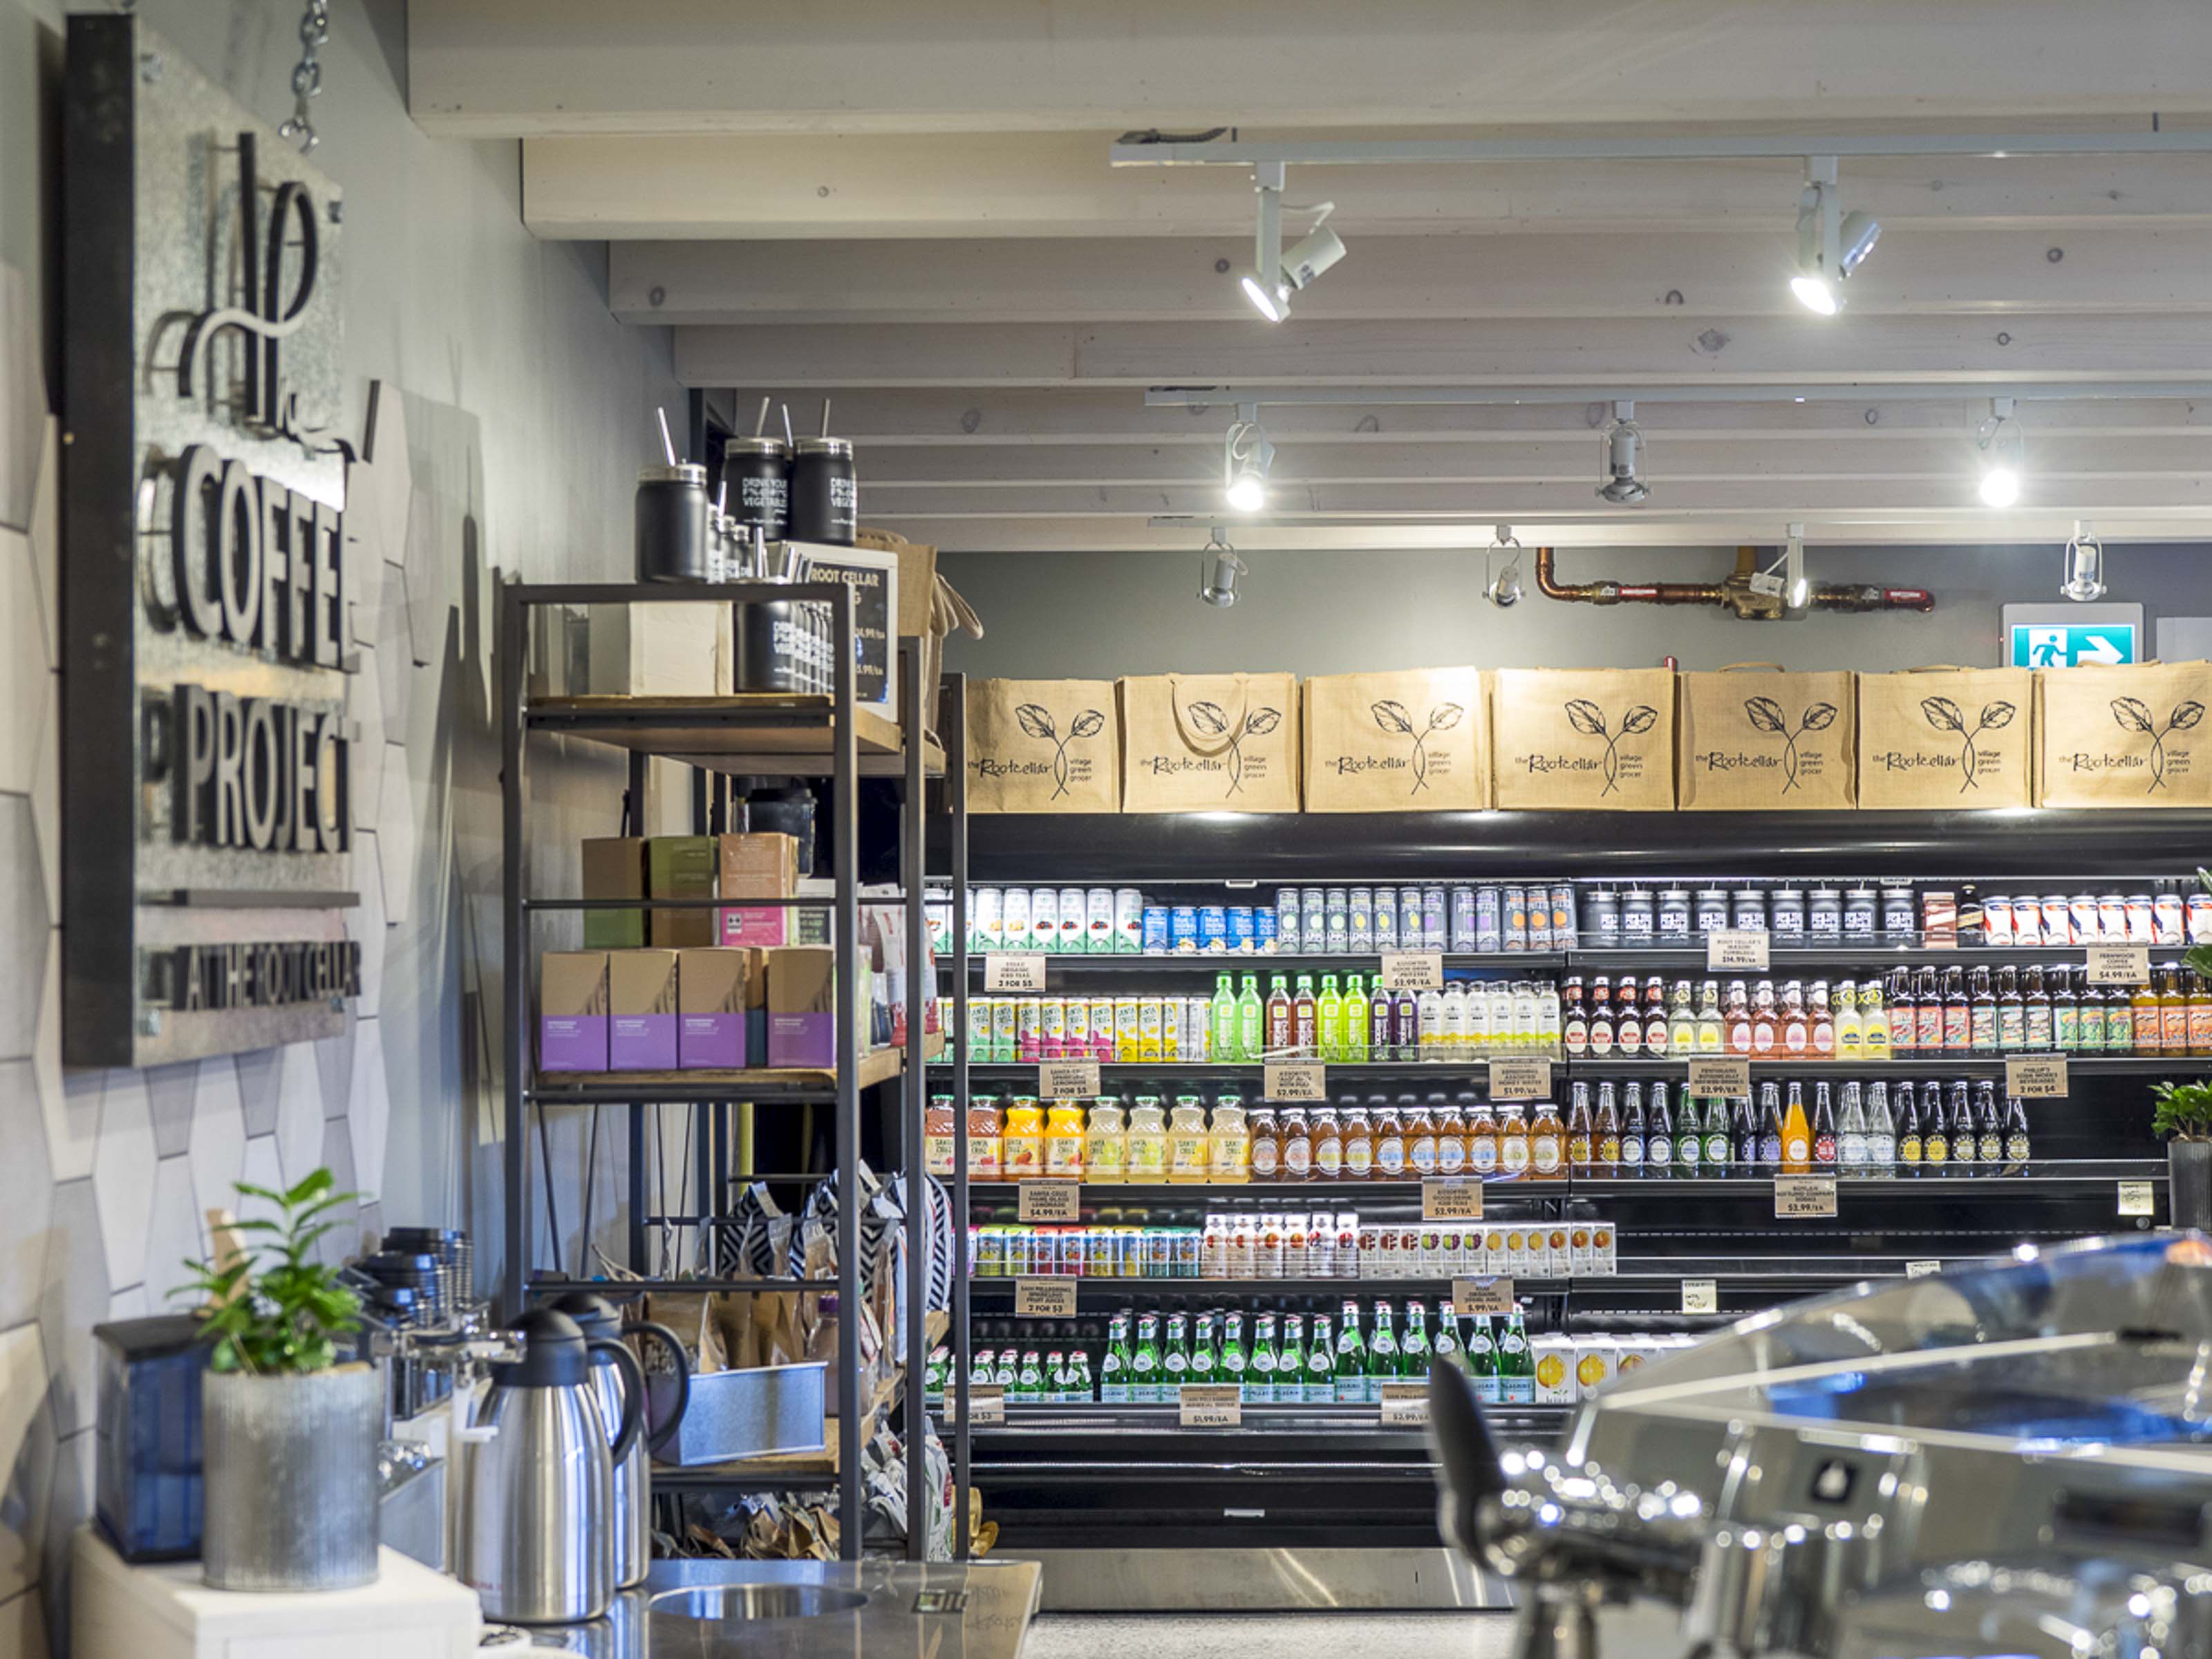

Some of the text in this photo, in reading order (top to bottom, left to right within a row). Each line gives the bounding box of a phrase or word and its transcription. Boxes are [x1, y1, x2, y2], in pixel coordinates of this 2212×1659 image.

[172, 442, 361, 673] COFFEE
[811, 567, 879, 587] ROOT CELLAR
[174, 682, 358, 854] PROJECT
